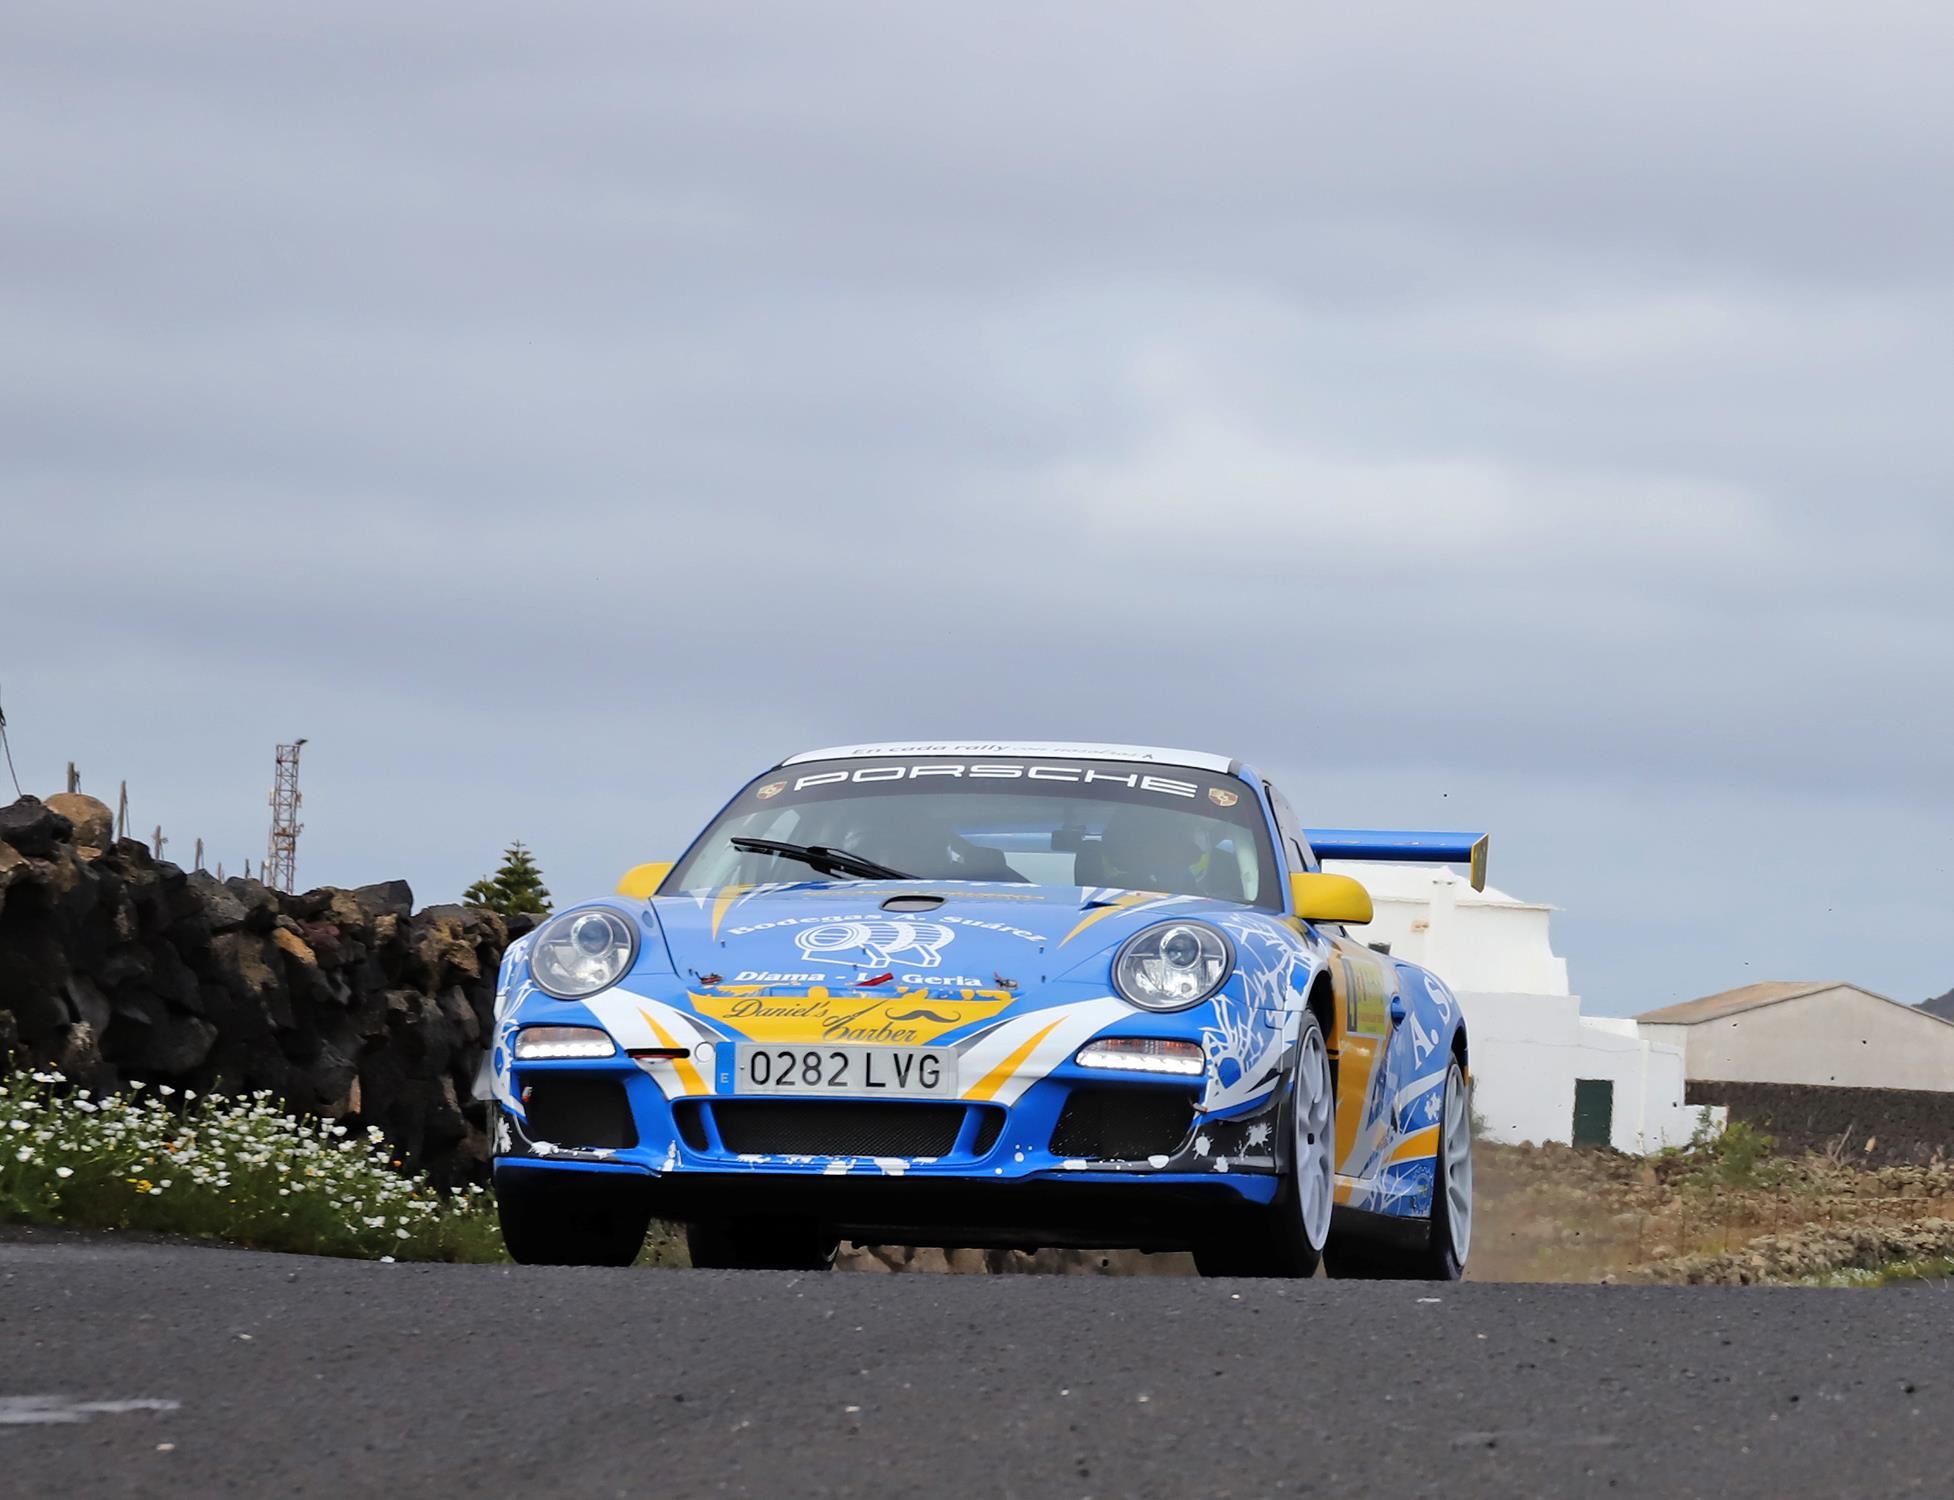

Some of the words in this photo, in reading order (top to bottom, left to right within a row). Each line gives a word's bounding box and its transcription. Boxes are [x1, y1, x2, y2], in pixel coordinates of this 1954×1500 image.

[954, 744, 1009, 752] rally
[794, 765, 1198, 798] PORSCHE
[727, 914, 882, 935] Bodegas
[892, 913, 926, 921] A.
[902, 974, 983, 987] Geria
[723, 999, 830, 1019] Daniel's
[720, 1073, 730, 1083] E
[750, 1051, 849, 1087] 0282
[865, 1052, 940, 1089] LVG
